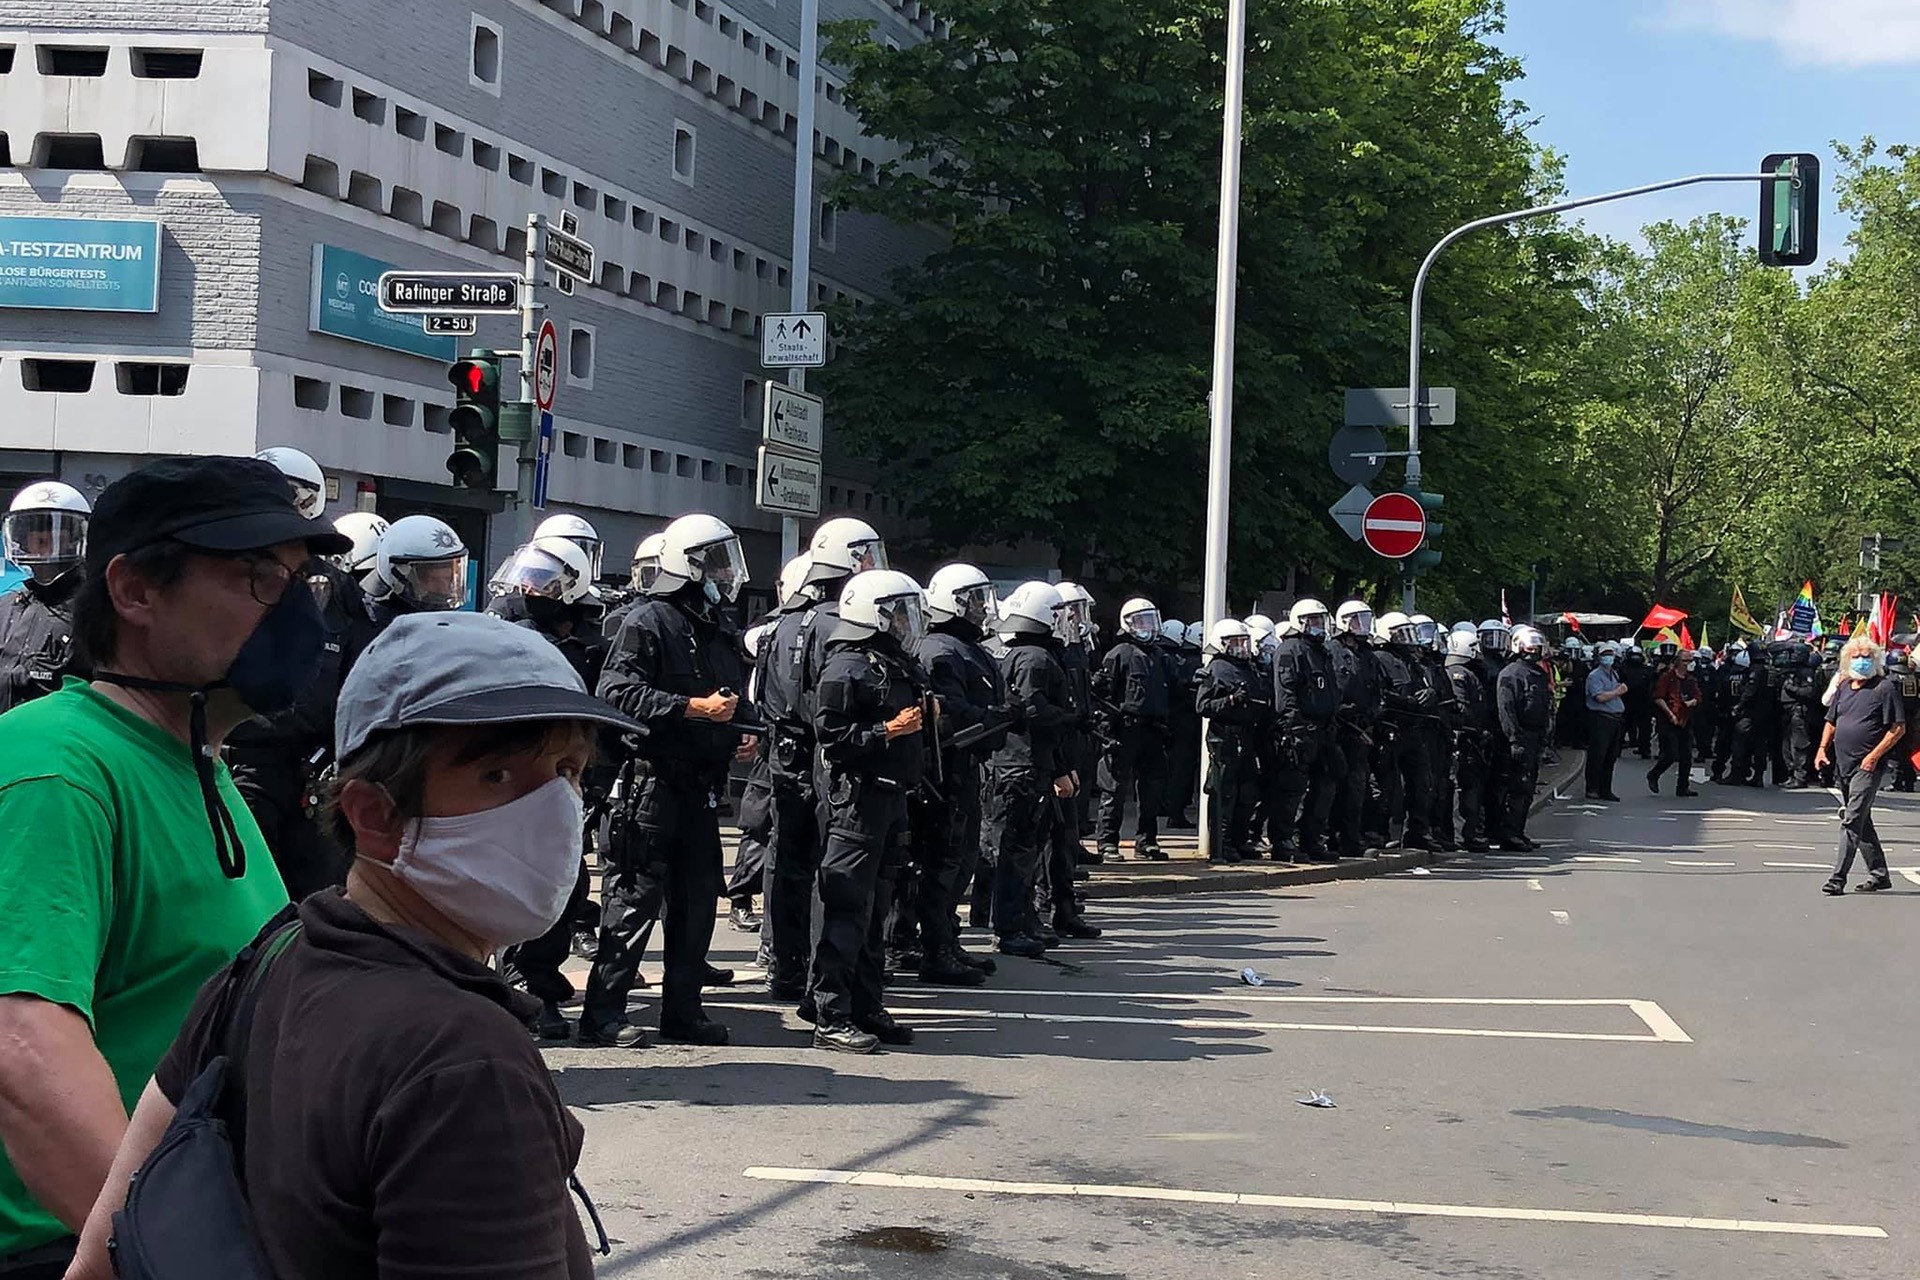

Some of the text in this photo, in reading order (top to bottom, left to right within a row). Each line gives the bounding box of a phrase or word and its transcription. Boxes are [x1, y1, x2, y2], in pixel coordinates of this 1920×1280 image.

[29, 265, 107, 279] BÜRGERTESTS
[395, 283, 507, 304] Ratinger Straße
[817, 534, 829, 549] 2
[844, 590, 855, 606] 2
